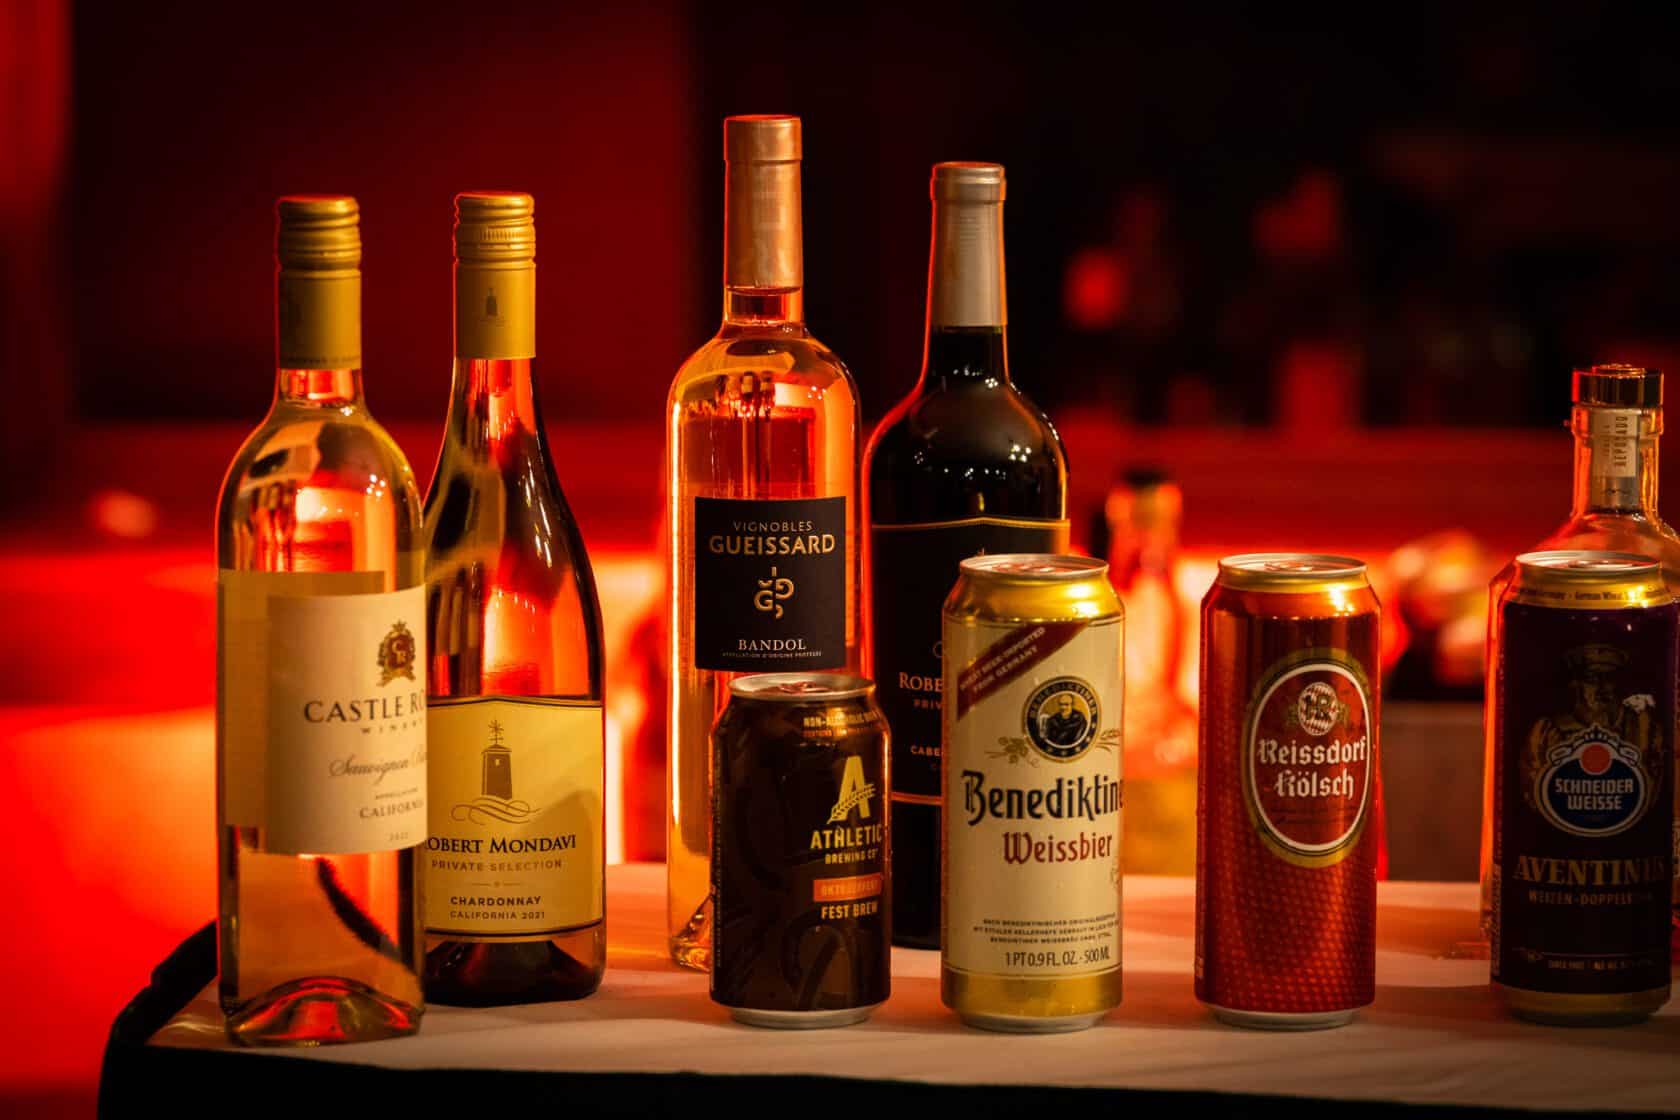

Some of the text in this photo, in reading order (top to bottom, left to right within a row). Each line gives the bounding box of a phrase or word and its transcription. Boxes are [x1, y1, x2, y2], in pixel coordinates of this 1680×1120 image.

[732, 520, 814, 533] VIGNOBLES
[708, 533, 836, 556] GUEISSARD
[738, 638, 808, 652] BANDOL
[898, 671, 943, 694] ROBE
[304, 698, 404, 724] CASTLE
[914, 700, 943, 711] PRIV
[911, 744, 943, 757] CABE
[1256, 736, 1367, 766] Reissdorf
[1273, 768, 1355, 801] Kölsch
[1553, 778, 1635, 794] SCHNEIDER
[359, 799, 424, 819] CALIFORN
[1567, 794, 1623, 811] WEISSE
[489, 834, 577, 854] MONDAVI
[809, 823, 882, 850] ATHLETIC
[1003, 831, 1114, 865] Weissbier
[431, 860, 562, 872] PRIVATE SELECTION
[824, 850, 866, 866] BREWING
[450, 895, 542, 907] CHARDONNAY
[450, 910, 546, 921] CALIFORNIA 2021
[820, 901, 878, 920] FEST BREW
[1005, 952, 1010, 966] 1
[1012, 951, 1026, 966] PT
[1028, 951, 1045, 967] 0.9
